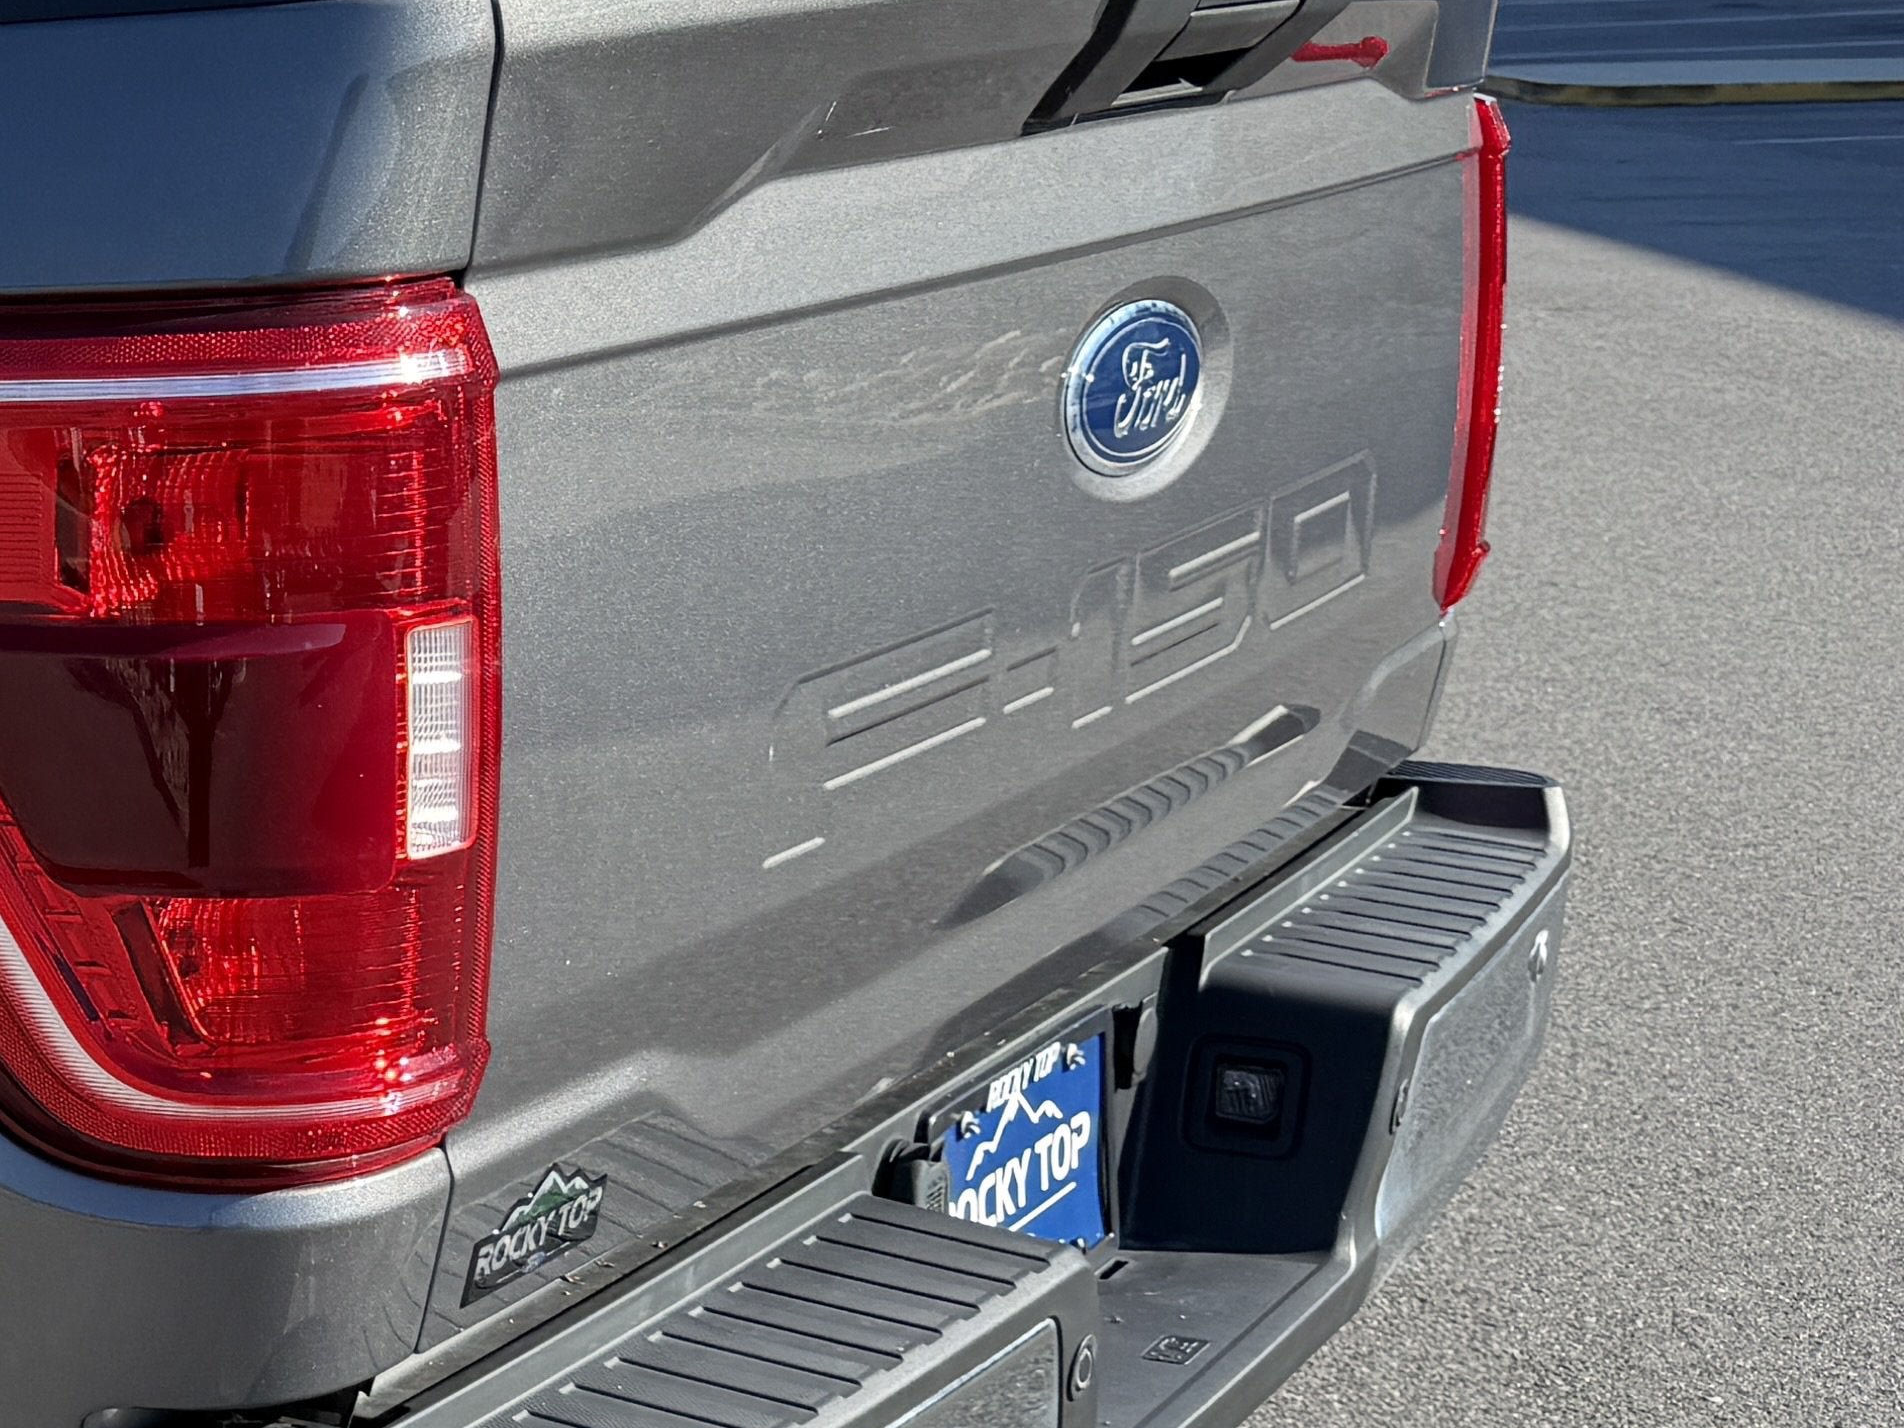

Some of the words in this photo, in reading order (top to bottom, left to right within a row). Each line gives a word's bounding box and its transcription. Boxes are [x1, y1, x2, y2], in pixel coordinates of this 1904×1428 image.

[1113, 337, 1187, 439] Ford
[986, 1059, 1035, 1113] ROCKY
[1034, 1042, 1061, 1083] TOP
[948, 1148, 1032, 1228] OCKY
[1034, 1110, 1091, 1192] TOP
[474, 1209, 556, 1280] ROCKY
[557, 1186, 603, 1237] TOP
